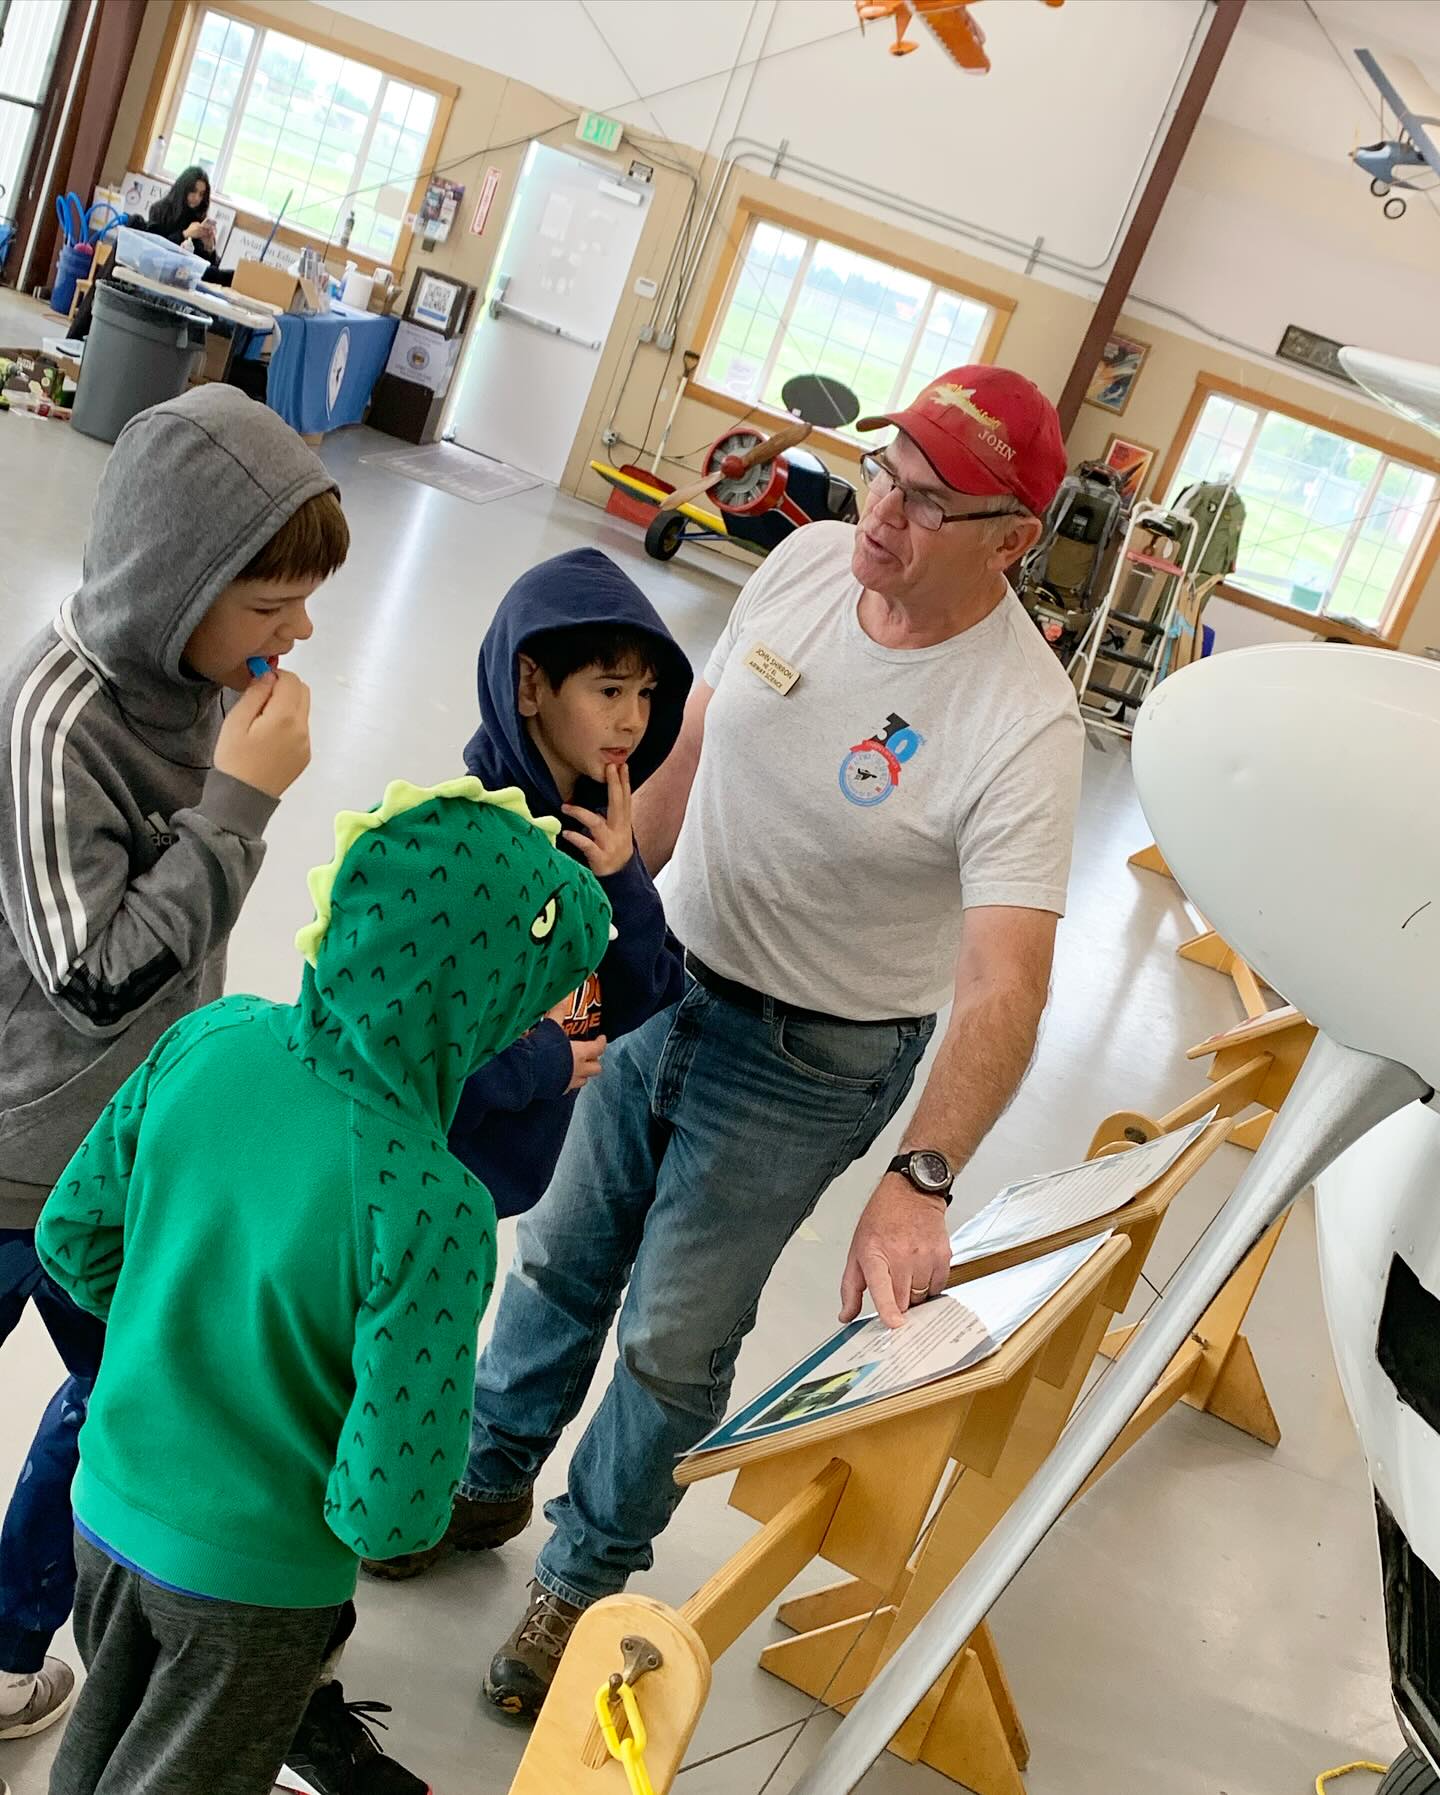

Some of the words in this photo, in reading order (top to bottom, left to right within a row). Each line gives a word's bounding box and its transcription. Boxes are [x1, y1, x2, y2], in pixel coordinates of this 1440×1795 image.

[582, 112, 619, 145] EXIT
[241, 235, 275, 257] Aviaton
[978, 428, 1017, 461] JOHN
[755, 648, 770, 662] JOHN
